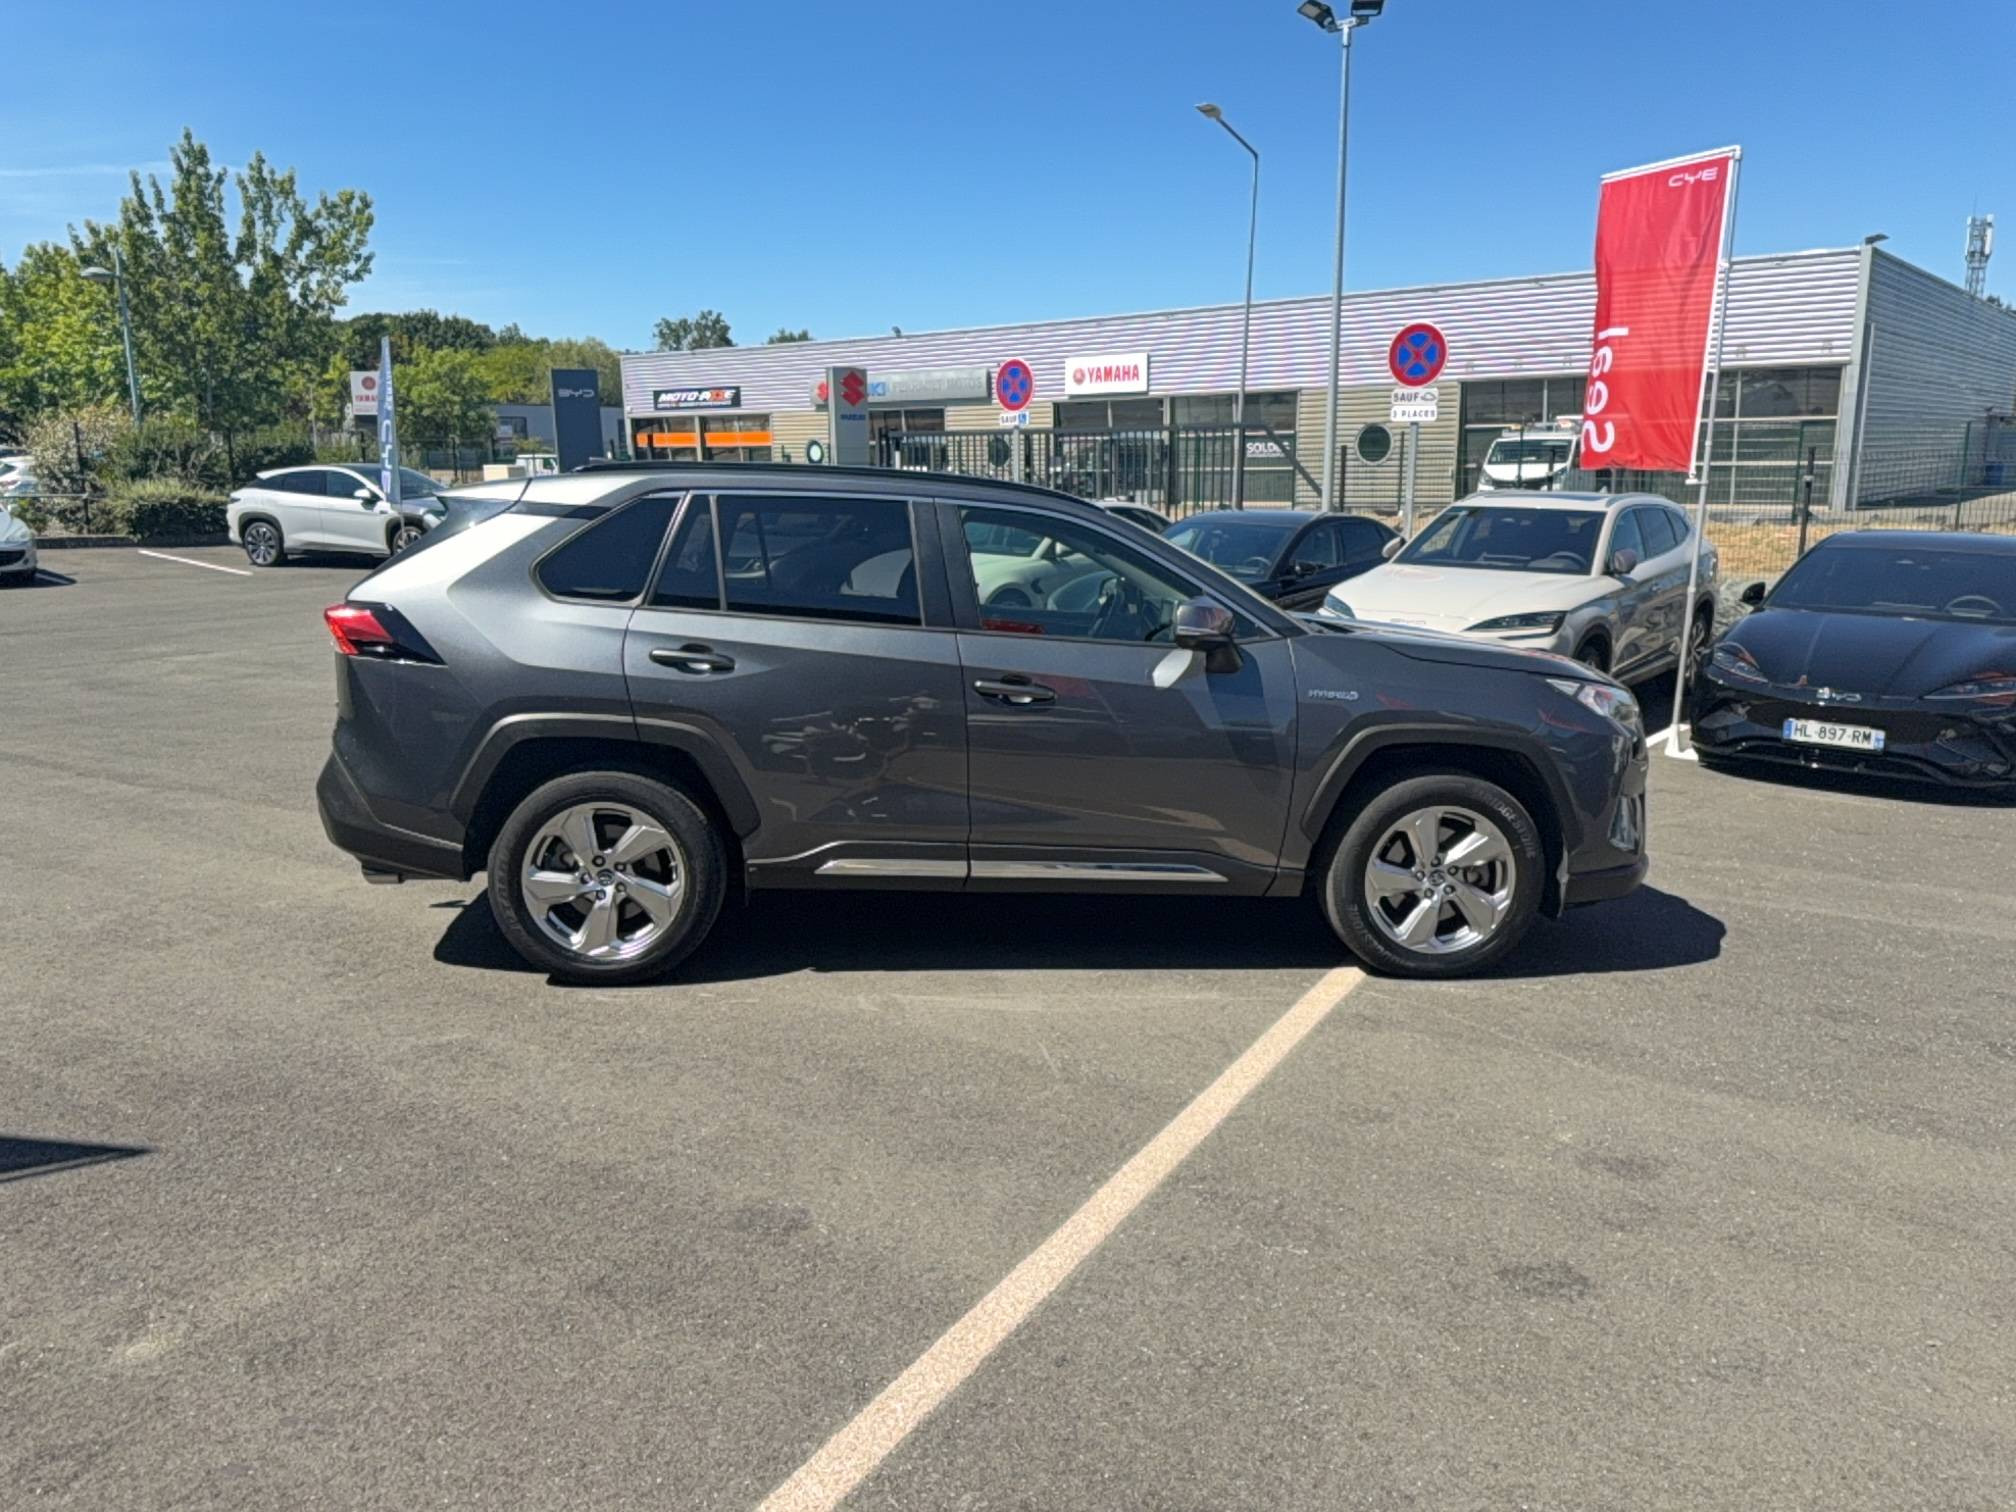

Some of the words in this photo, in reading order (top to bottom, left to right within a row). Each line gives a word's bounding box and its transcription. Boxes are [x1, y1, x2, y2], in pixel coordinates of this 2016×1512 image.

[1087, 364, 1140, 384] YAMAHA
[558, 388, 595, 398] BYD
[1393, 391, 1420, 402] SAUF
